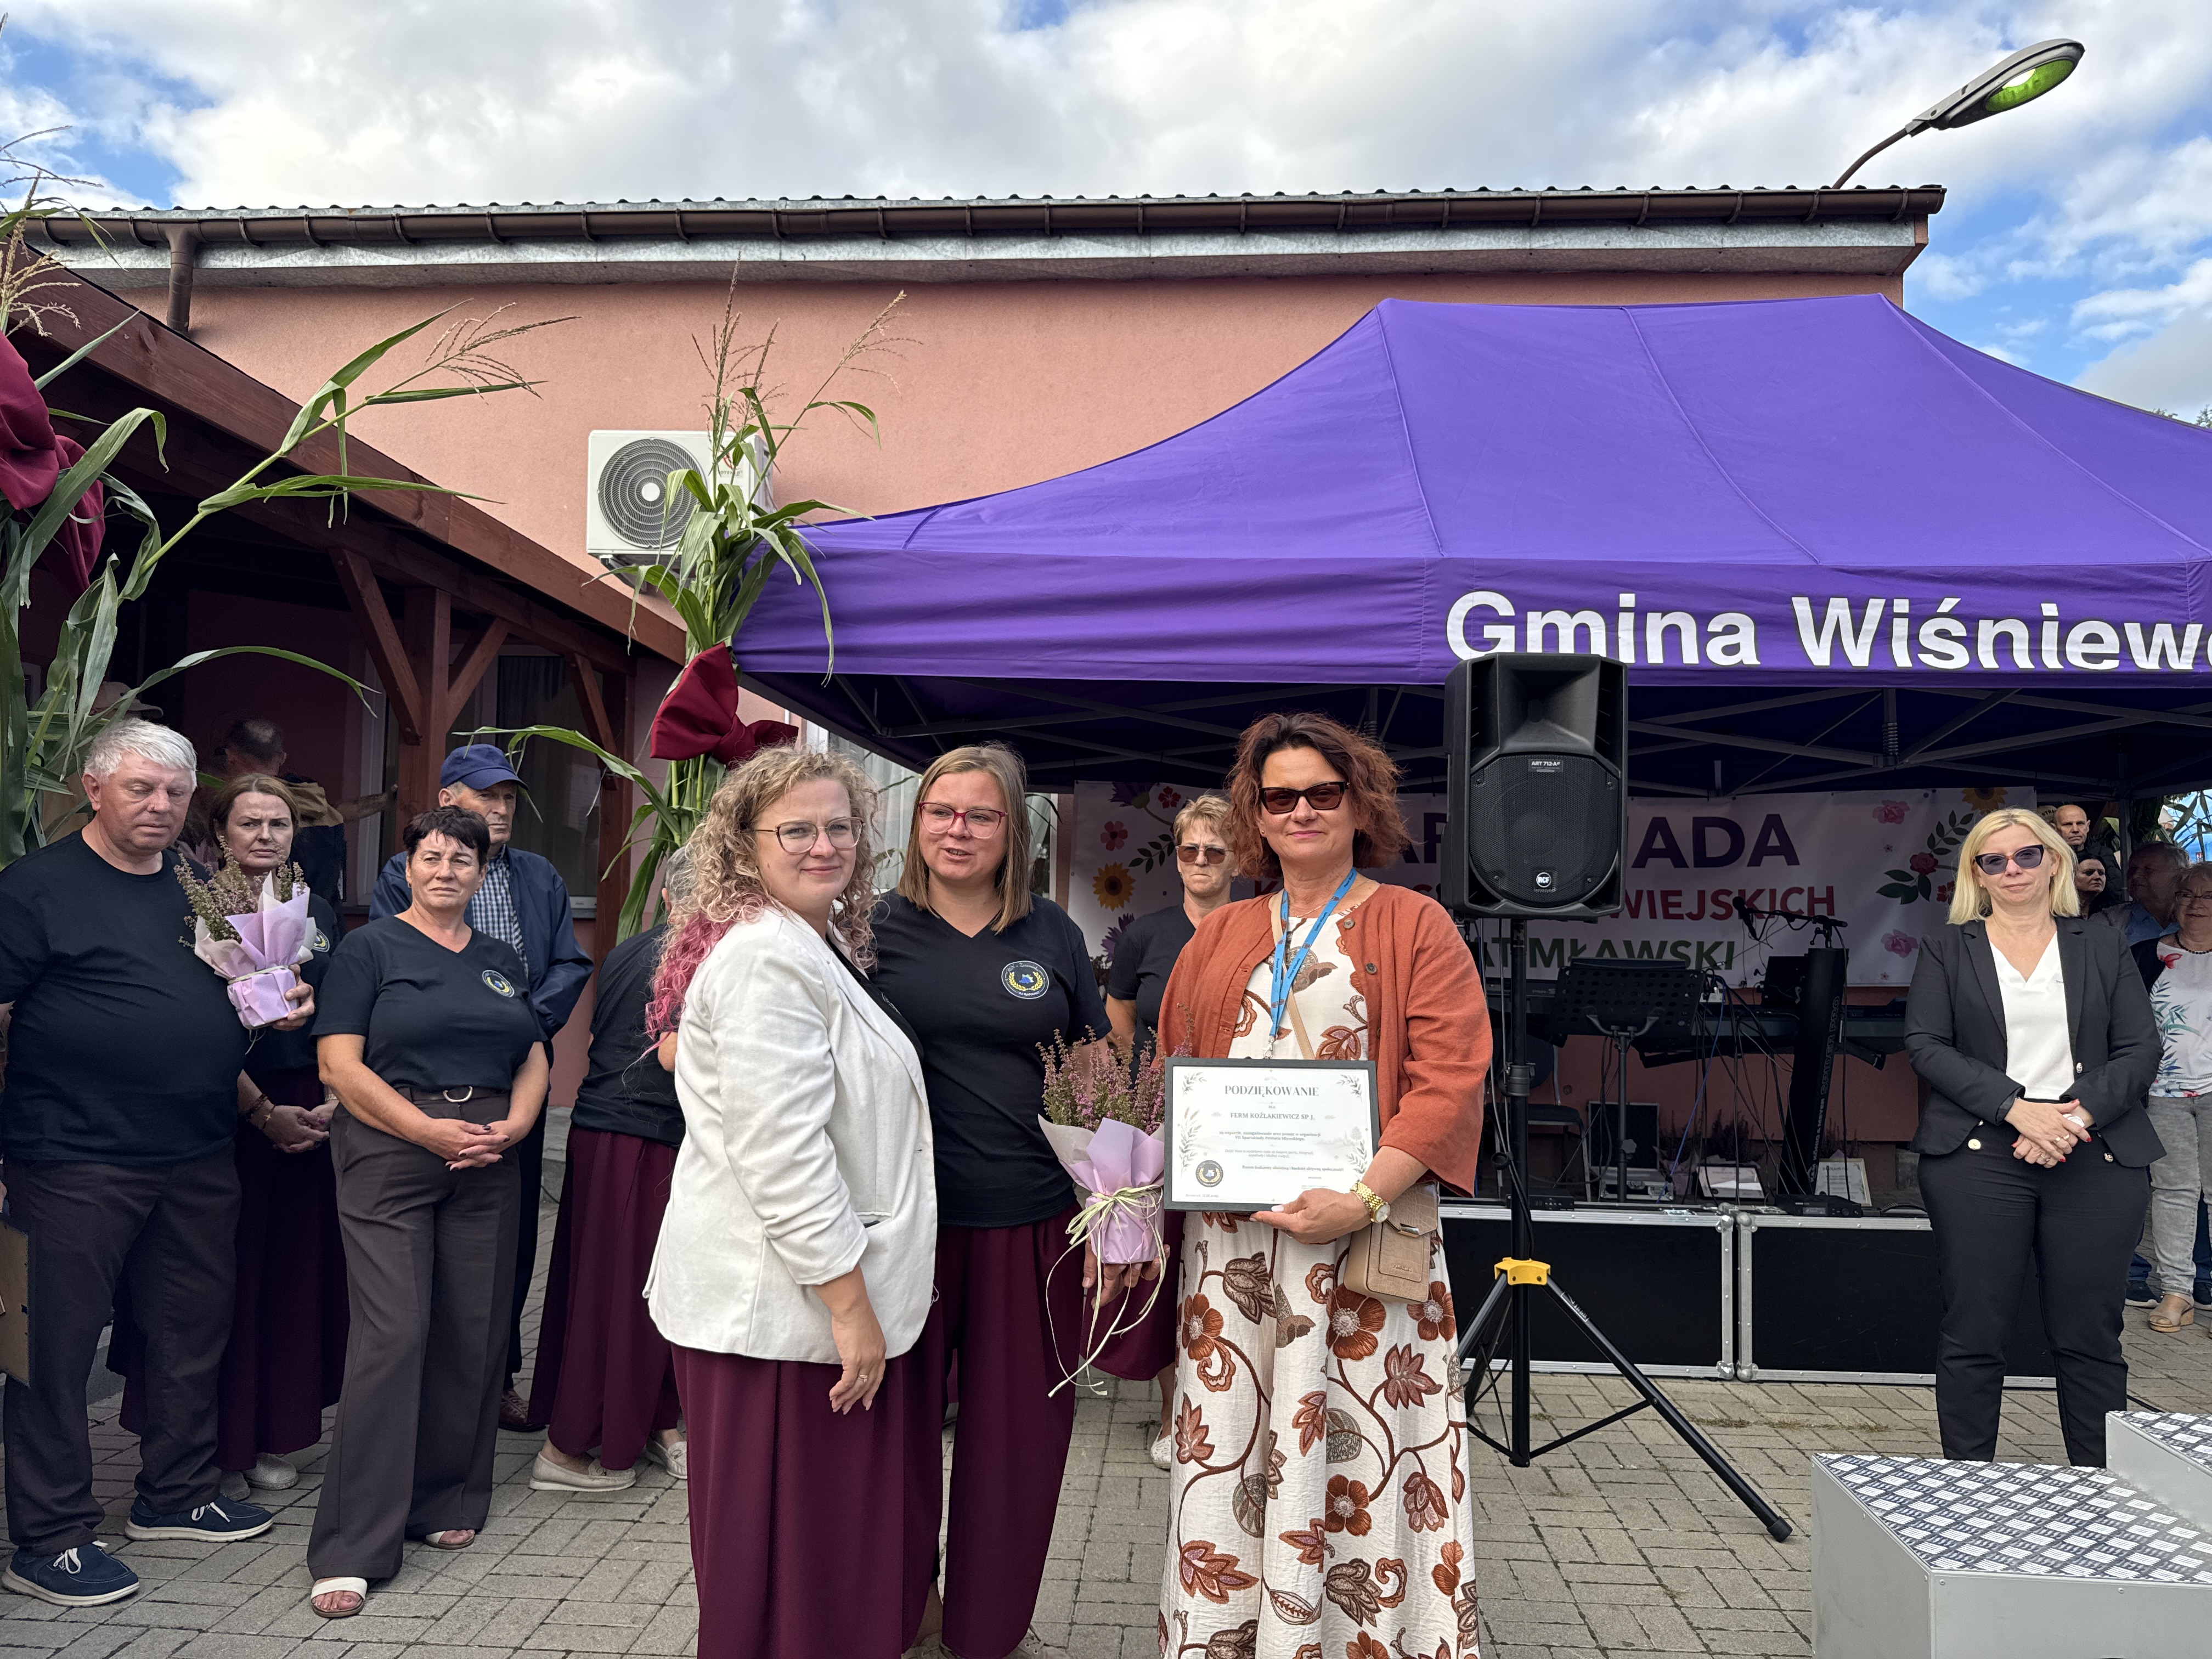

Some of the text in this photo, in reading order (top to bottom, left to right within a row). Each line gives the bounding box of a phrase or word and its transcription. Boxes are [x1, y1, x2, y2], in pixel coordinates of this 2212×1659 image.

[1446, 591, 2212, 670] Gmina Wiśniew
[1609, 885, 1835, 921] WIEJSKICH
[1528, 938, 1735, 970] MŁAWSKI
[1820, 996, 1841, 1096] SPIDER PRO
[1224, 1085, 1319, 1097] PODZIĘKOWANIE
[1812, 1135, 1820, 1160] KÖNIG
[1817, 1098, 1825, 1126] MEYER
